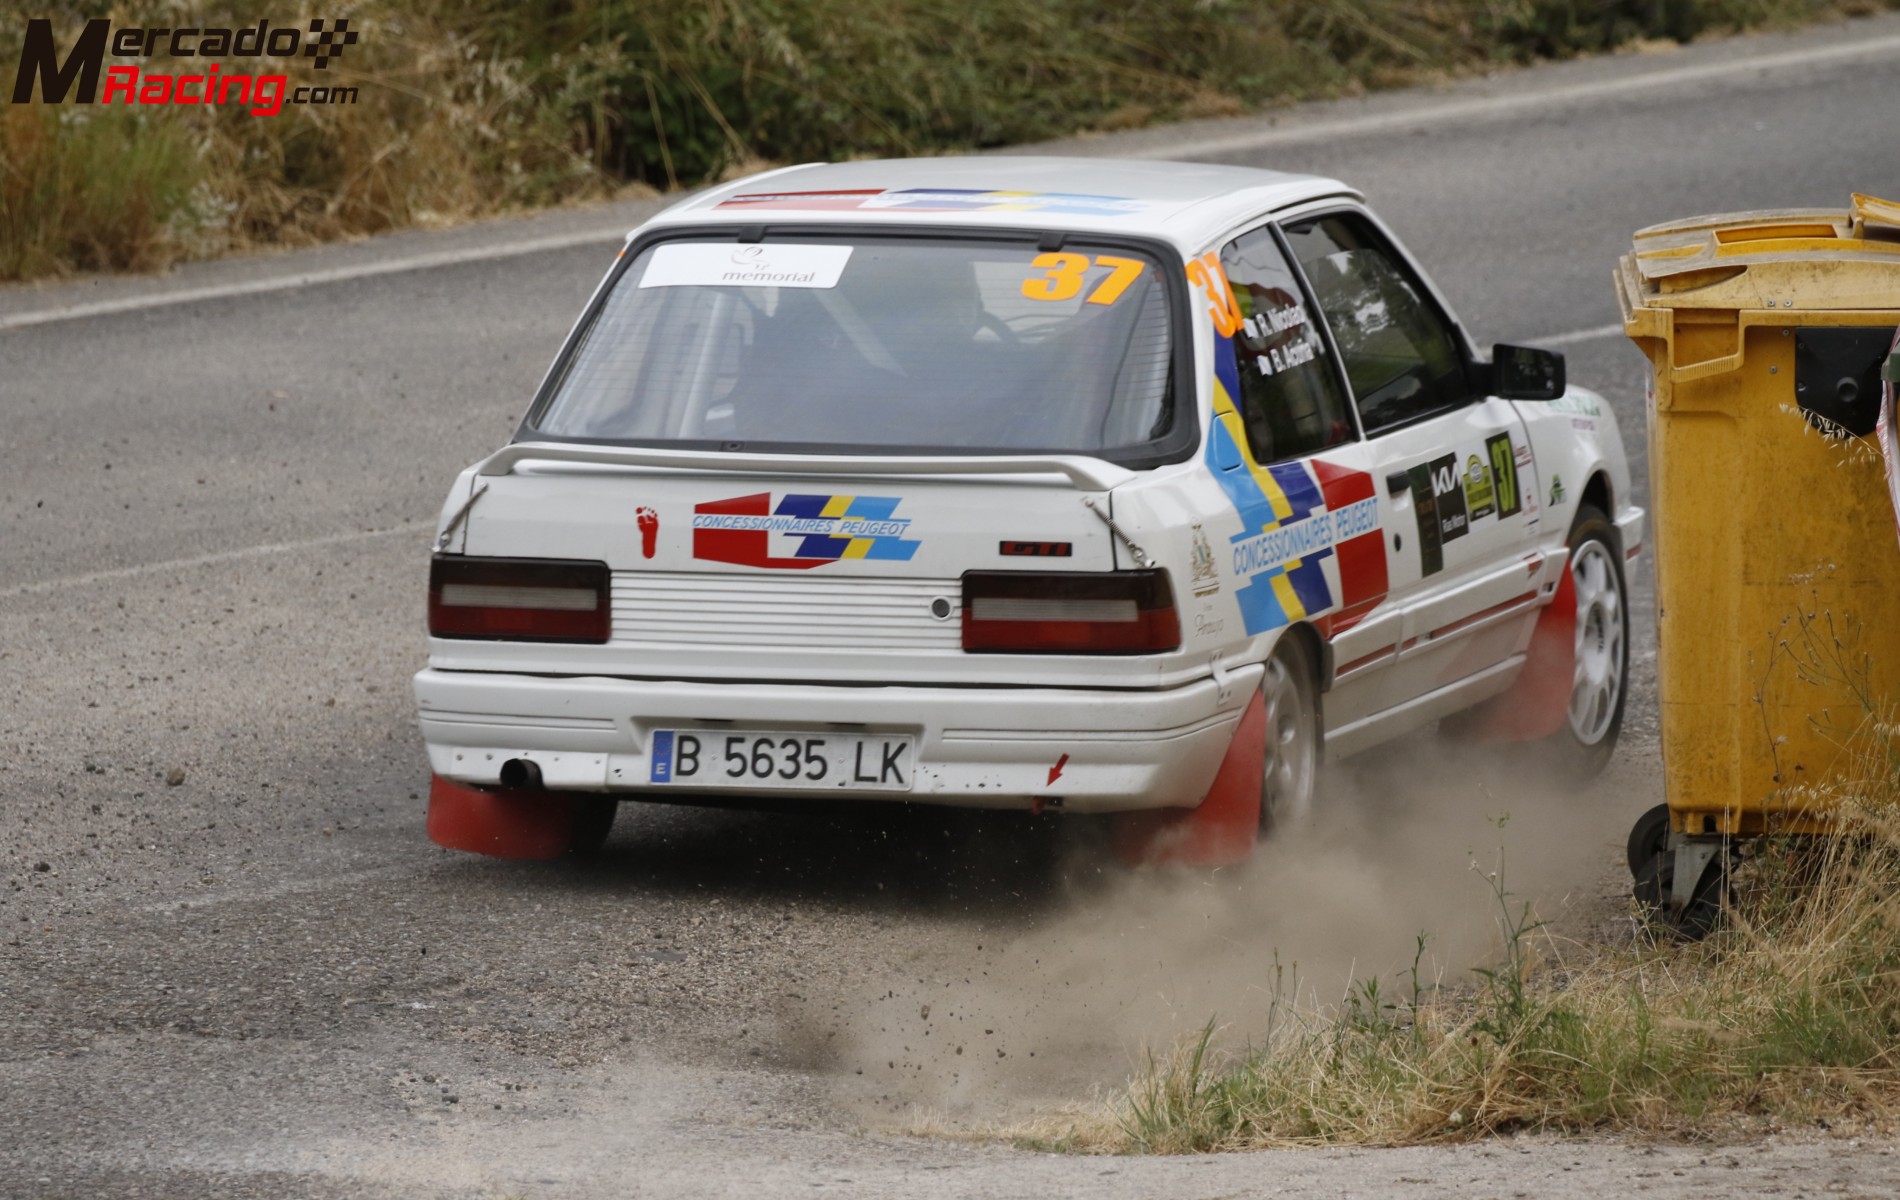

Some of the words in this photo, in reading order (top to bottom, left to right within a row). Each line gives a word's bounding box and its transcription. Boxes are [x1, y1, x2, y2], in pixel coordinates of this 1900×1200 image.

[722, 271, 815, 283] memorial
[1021, 252, 1145, 305] 37
[1185, 252, 1245, 338] 37
[1491, 437, 1516, 512] 37
[692, 515, 834, 533] CONCESSIONNAIRES
[839, 521, 911, 536] PEUGEOT
[1002, 541, 1068, 556] GTI
[1233, 514, 1333, 576] CONCESSIONNAIRES
[1335, 497, 1379, 540] PEUGEOT
[655, 763, 666, 775] E
[675, 735, 701, 776] B
[725, 737, 828, 780] 5635
[854, 741, 908, 784] LK
